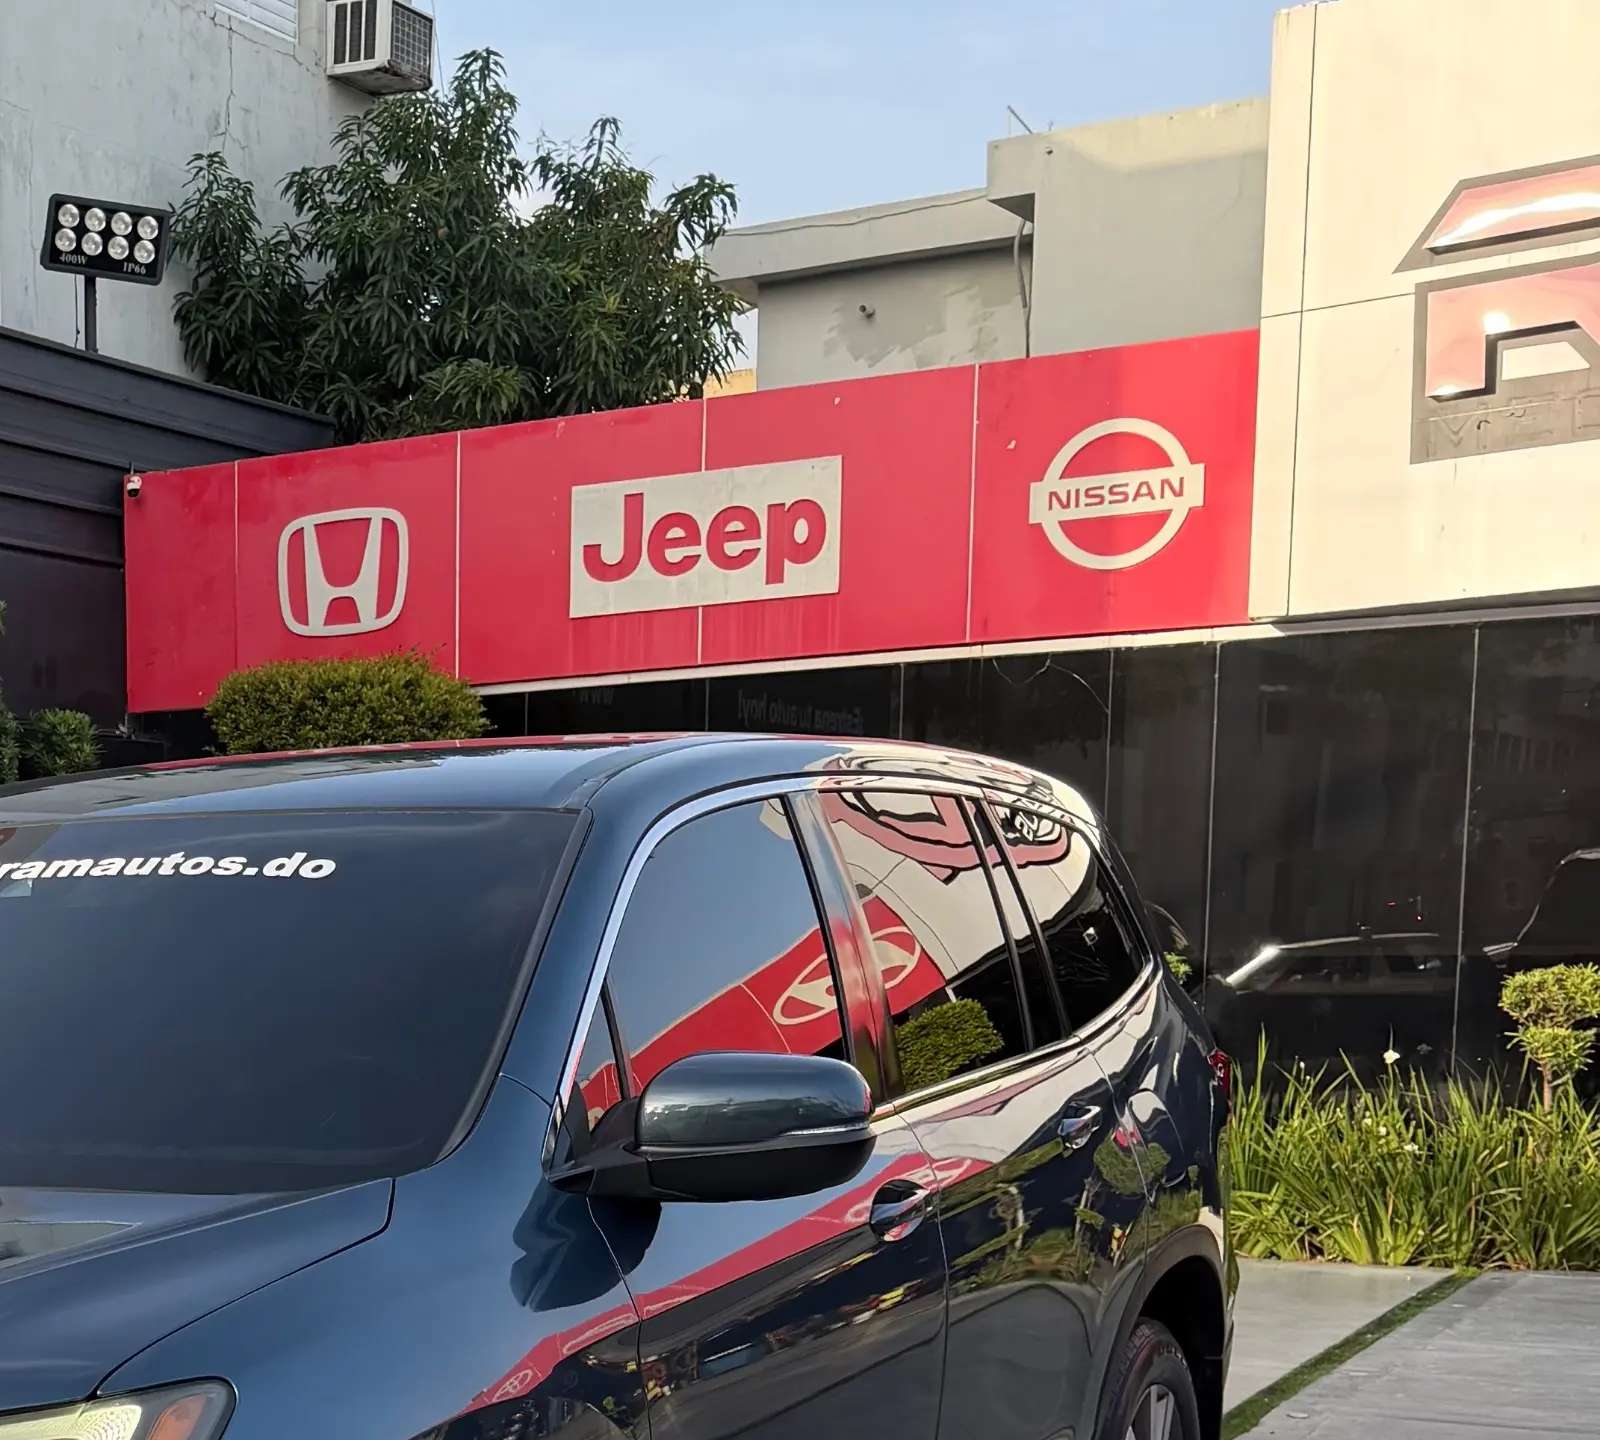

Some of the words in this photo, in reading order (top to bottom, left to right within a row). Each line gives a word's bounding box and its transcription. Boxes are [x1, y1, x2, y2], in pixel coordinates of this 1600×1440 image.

[59, 252, 88, 265] 400W
[122, 261, 147, 275] IP66
[1047, 475, 1186, 512] NISSAN
[582, 492, 828, 586] Jeep
